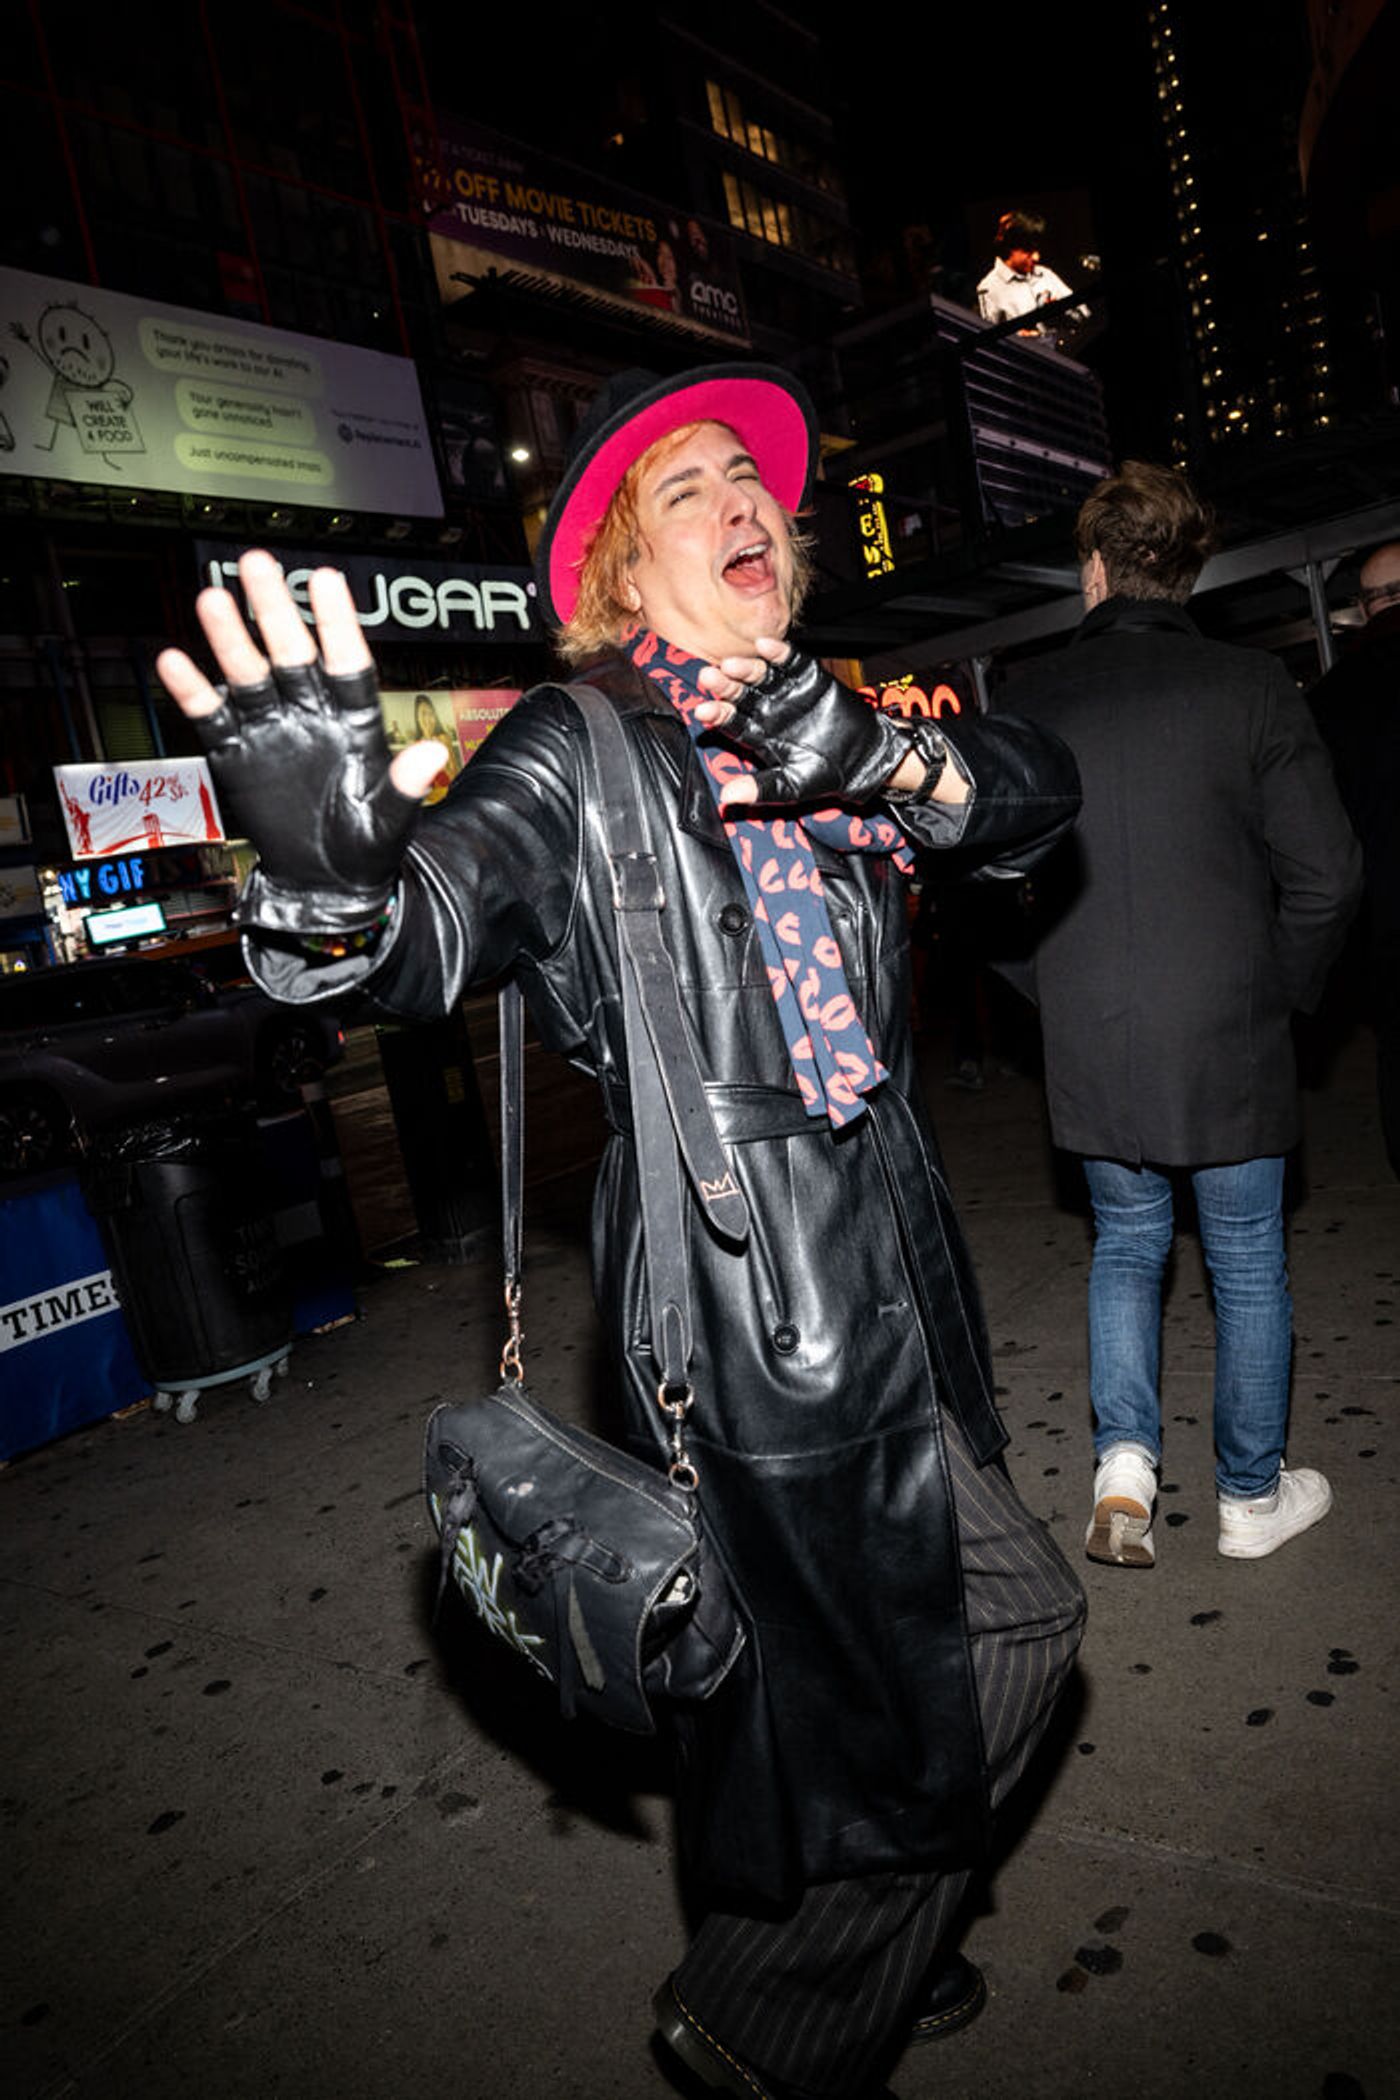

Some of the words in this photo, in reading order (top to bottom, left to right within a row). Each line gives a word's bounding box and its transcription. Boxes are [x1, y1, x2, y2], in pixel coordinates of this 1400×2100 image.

[455, 168, 501, 204] OFF
[503, 179, 575, 225] MOVIE
[576, 200, 658, 242] TICKETS
[455, 202, 539, 238] TUESDAYS
[546, 223, 642, 258] WEDNESDAYS
[82, 414, 128, 429] CREATE
[85, 399, 115, 413] WILL
[98, 429, 133, 443] FOOD
[89, 771, 140, 806] Gifts
[57, 866, 92, 904] NY
